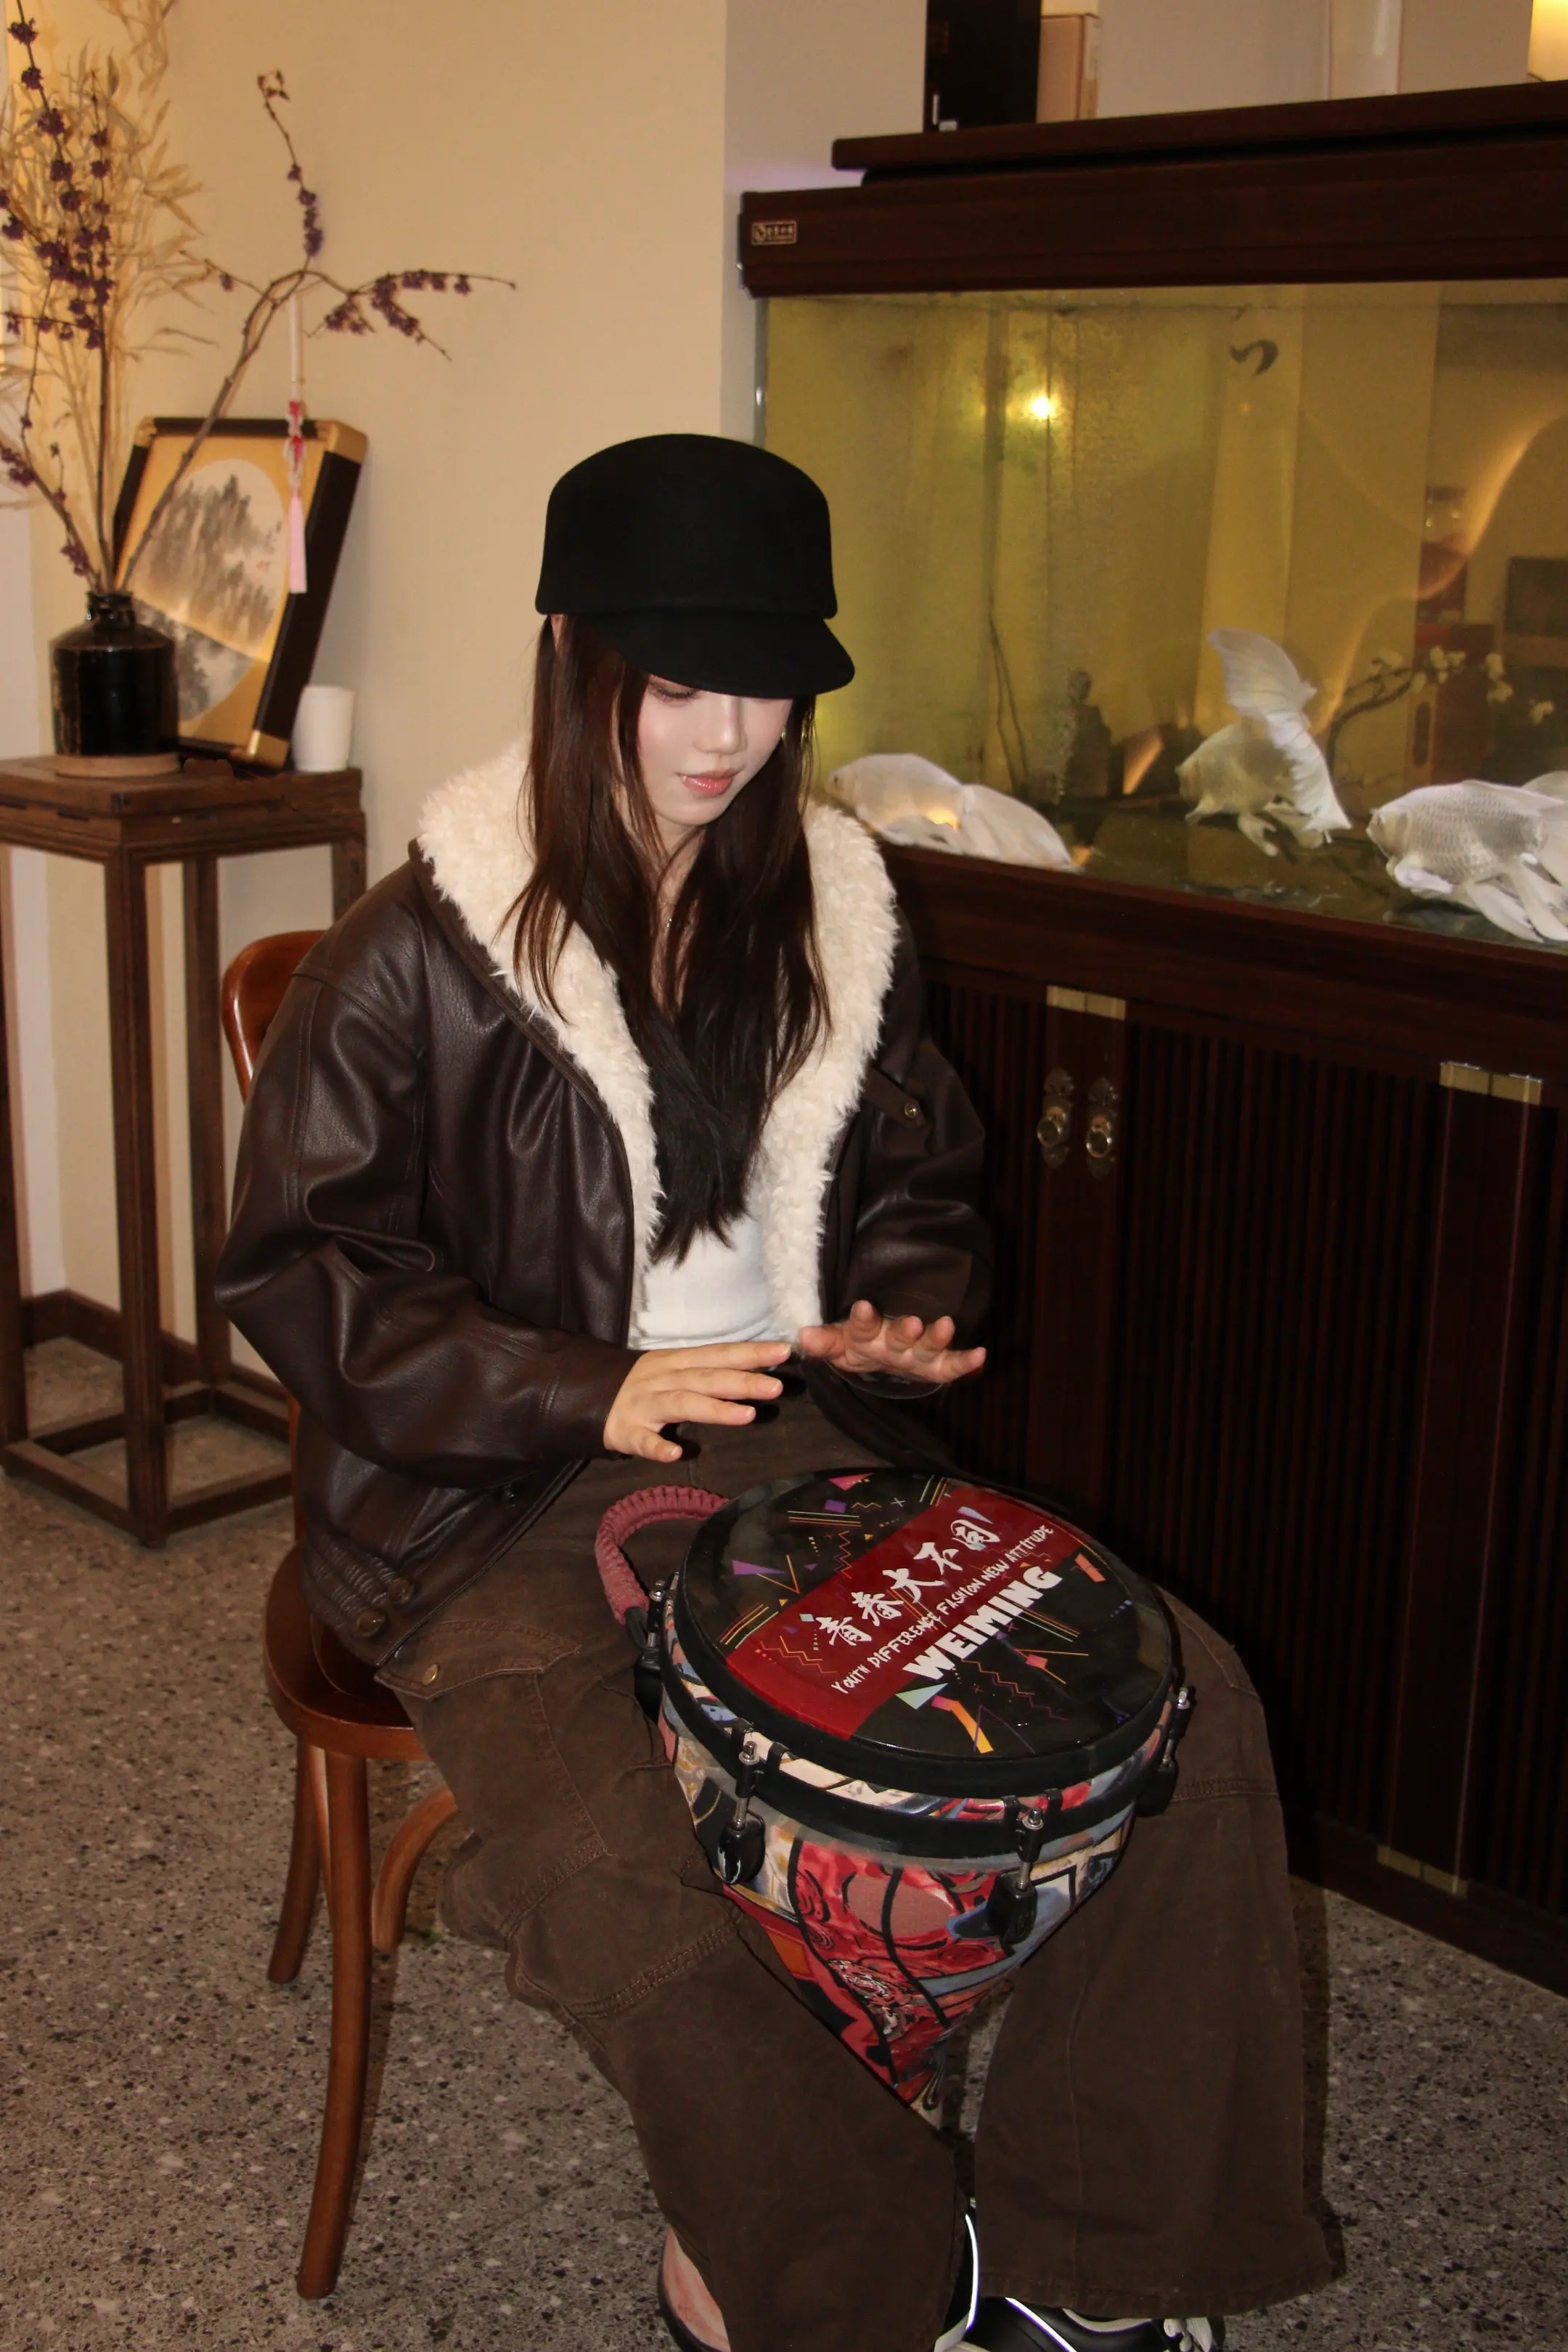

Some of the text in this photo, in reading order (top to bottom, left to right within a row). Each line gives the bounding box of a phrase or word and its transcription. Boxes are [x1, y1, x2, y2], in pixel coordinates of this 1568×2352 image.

[816, 1519, 1000, 1646] 青春大不同
[831, 1524, 1054, 1694] YOUTH DIFFERENCE FASHION NEW ATTITUDE
[902, 1566, 1063, 1680] WEIMING
